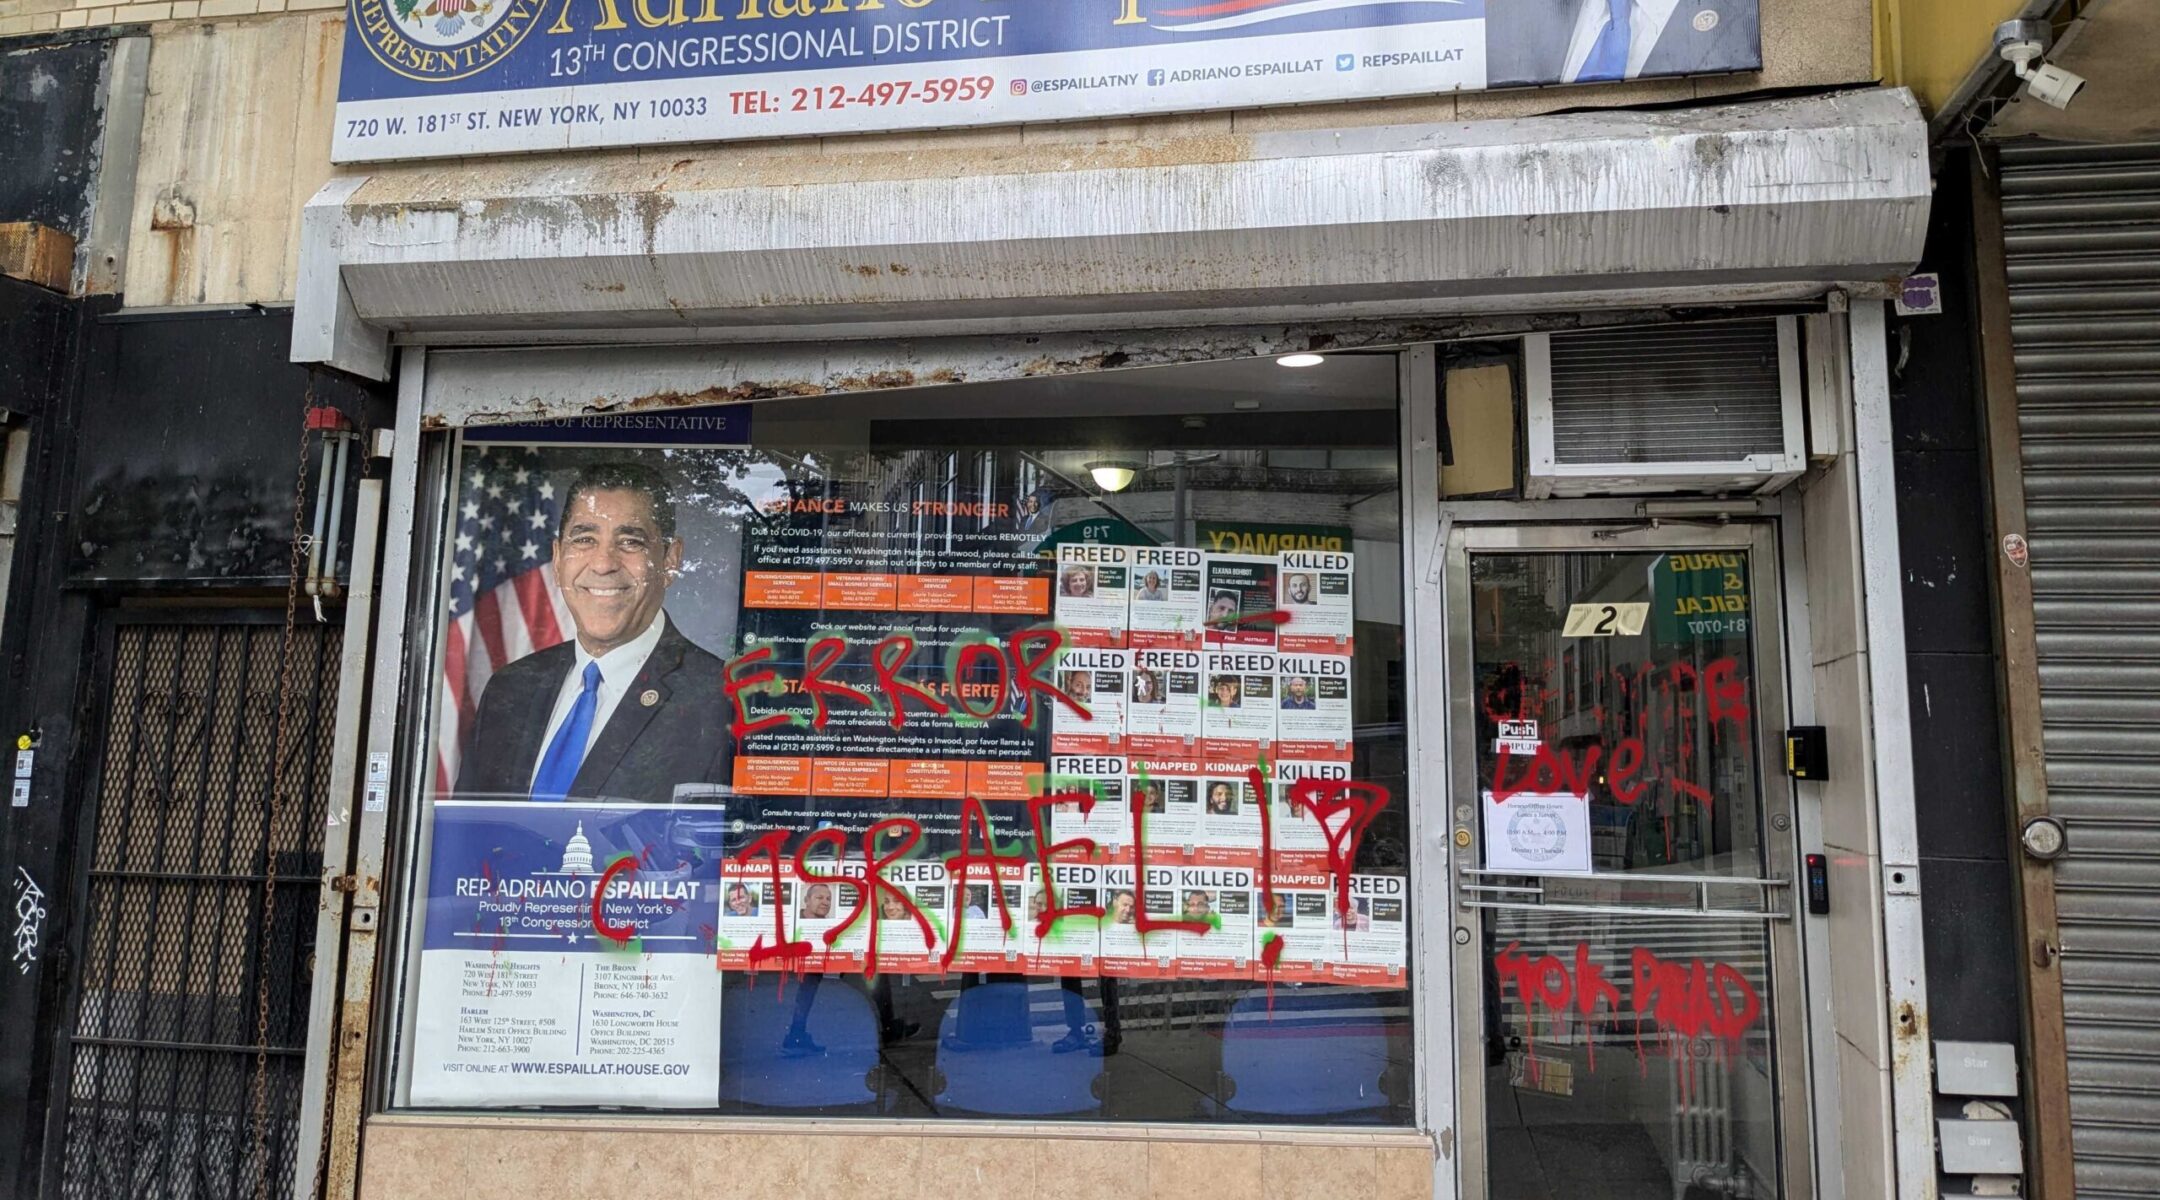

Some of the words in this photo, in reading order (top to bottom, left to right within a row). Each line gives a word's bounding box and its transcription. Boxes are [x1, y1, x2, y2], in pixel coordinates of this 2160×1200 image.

[360, 0, 541, 73] EPRESENTATIV
[550, 44, 606, 77] 13TH
[613, 28, 864, 72] CONGRESSIONAL
[873, 15, 1011, 55] DISTRICT
[1362, 48, 1464, 68] REPSPAILLAT
[1169, 66, 1241, 84] ADRIANO
[1245, 59, 1323, 79] ESPAILLAT
[1031, 73, 1139, 94] @ESPAILLATNY
[729, 91, 780, 115] TEL:
[791, 76, 996, 112] 212-497-5959
[346, 119, 379, 138] 720
[386, 117, 407, 136] W.
[417, 113, 462, 133] 181ST
[466, 112, 490, 131] ST.
[498, 108, 542, 129] NEW
[549, 104, 605, 126] YORK,
[613, 101, 641, 120] NY
[649, 97, 707, 118] 10033
[554, 418, 576, 428] OF
[582, 415, 726, 431] REPRESENTATIVE
[850, 502, 890, 513] MAKES
[893, 502, 908, 514] US
[911, 501, 1009, 518] STRONGER
[751, 527, 769, 536] Due
[770, 528, 780, 536] to
[781, 528, 825, 538] COVID-19,
[826, 530, 841, 538] our
[842, 528, 870, 538] offices
[871, 531, 885, 539] are
[886, 530, 922, 541] currently
[924, 531, 963, 542] providing
[965, 532, 998, 541] services
[999, 532, 1047, 542] REMOTELY
[753, 545, 761, 554] If
[761, 547, 777, 556] you
[779, 546, 800, 554] need
[801, 546, 842, 555] assistance
[844, 546, 852, 555] in
[853, 546, 902, 557] Washington
[904, 549, 936, 559] Heights
[948, 550, 982, 559] Inwood,
[983, 551, 1010, 560] please
[1011, 550, 1025, 559] call
[1027, 551, 1041, 559] the
[1062, 546, 1127, 564] FREED
[1136, 549, 1202, 567] FREED
[1283, 552, 1349, 570] KILLED
[757, 556, 781, 565] office
[782, 557, 791, 565] at
[792, 556, 814, 566] (212)
[815, 557, 854, 567] 497-5959
[854, 559, 864, 567] or
[865, 557, 888, 567] reach
[890, 558, 904, 567] out
[905, 559, 937, 570] directly
[956, 560, 990, 569] member
[992, 560, 1002, 569] of
[1003, 562, 1016, 571] my
[1017, 561, 1038, 571] staff:
[810, 622, 834, 631] Check
[835, 623, 847, 631] our
[848, 622, 876, 632] website
[877, 623, 892, 632] and
[893, 624, 914, 633] social
[914, 624, 937, 633] media
[938, 624, 950, 633] for
[950, 626, 979, 635] updates
[1058, 652, 1125, 669] KILLED
[1134, 651, 1200, 669] FREED
[1208, 654, 1274, 672] FREED
[1279, 657, 1346, 676] KILLED
[721, 627, 1093, 742] ERROR
[1501, 723, 1535, 736] Push
[752, 733, 773, 742] usted
[774, 733, 805, 742] necesita
[805, 734, 841, 743] asistencia
[853, 734, 897, 745] Washington
[897, 736, 926, 746] Heights
[934, 737, 965, 747] Inwood,
[965, 739, 979, 748] por
[979, 737, 999, 746] favor
[999, 737, 1020, 747] llame
[1027, 737, 1035, 747] la
[747, 743, 772, 752] oficina
[772, 743, 780, 752] al
[780, 743, 800, 753] (212)
[800, 744, 835, 753] 497-5959
[842, 745, 874, 754] contacte
[875, 745, 925, 754] directamente
[925, 747, 931, 755] a
[942, 747, 972, 756] miembro
[972, 747, 986, 757] de
[988, 747, 998, 756] mi
[998, 748, 1032, 758] personal:
[1056, 757, 1123, 775] FREED
[1130, 761, 1198, 773] KDNAPPED
[1278, 763, 1346, 782] KILLED
[1105, 869, 1174, 886] KILED
[1179, 870, 1247, 887] KILLED
[455, 879, 491, 898] REP.
[496, 879, 585, 899] ADRIANO
[478, 901, 521, 917] Proudly
[525, 902, 603, 918] Representin
[606, 903, 633, 915] New
[637, 903, 673, 915] York's
[498, 916, 519, 928] 13th
[521, 917, 606, 932] Congression
[608, 918, 649, 930] District
[442, 1063, 465, 1073] VISIT
[465, 1063, 497, 1074] ONLINE
[498, 1064, 509, 1073] AT
[511, 1062, 690, 1076] WWW.ESPAILLAT.HOUSE.GOV
[1963, 1056, 1989, 1069] Star
[1967, 1135, 1991, 1147] Star
